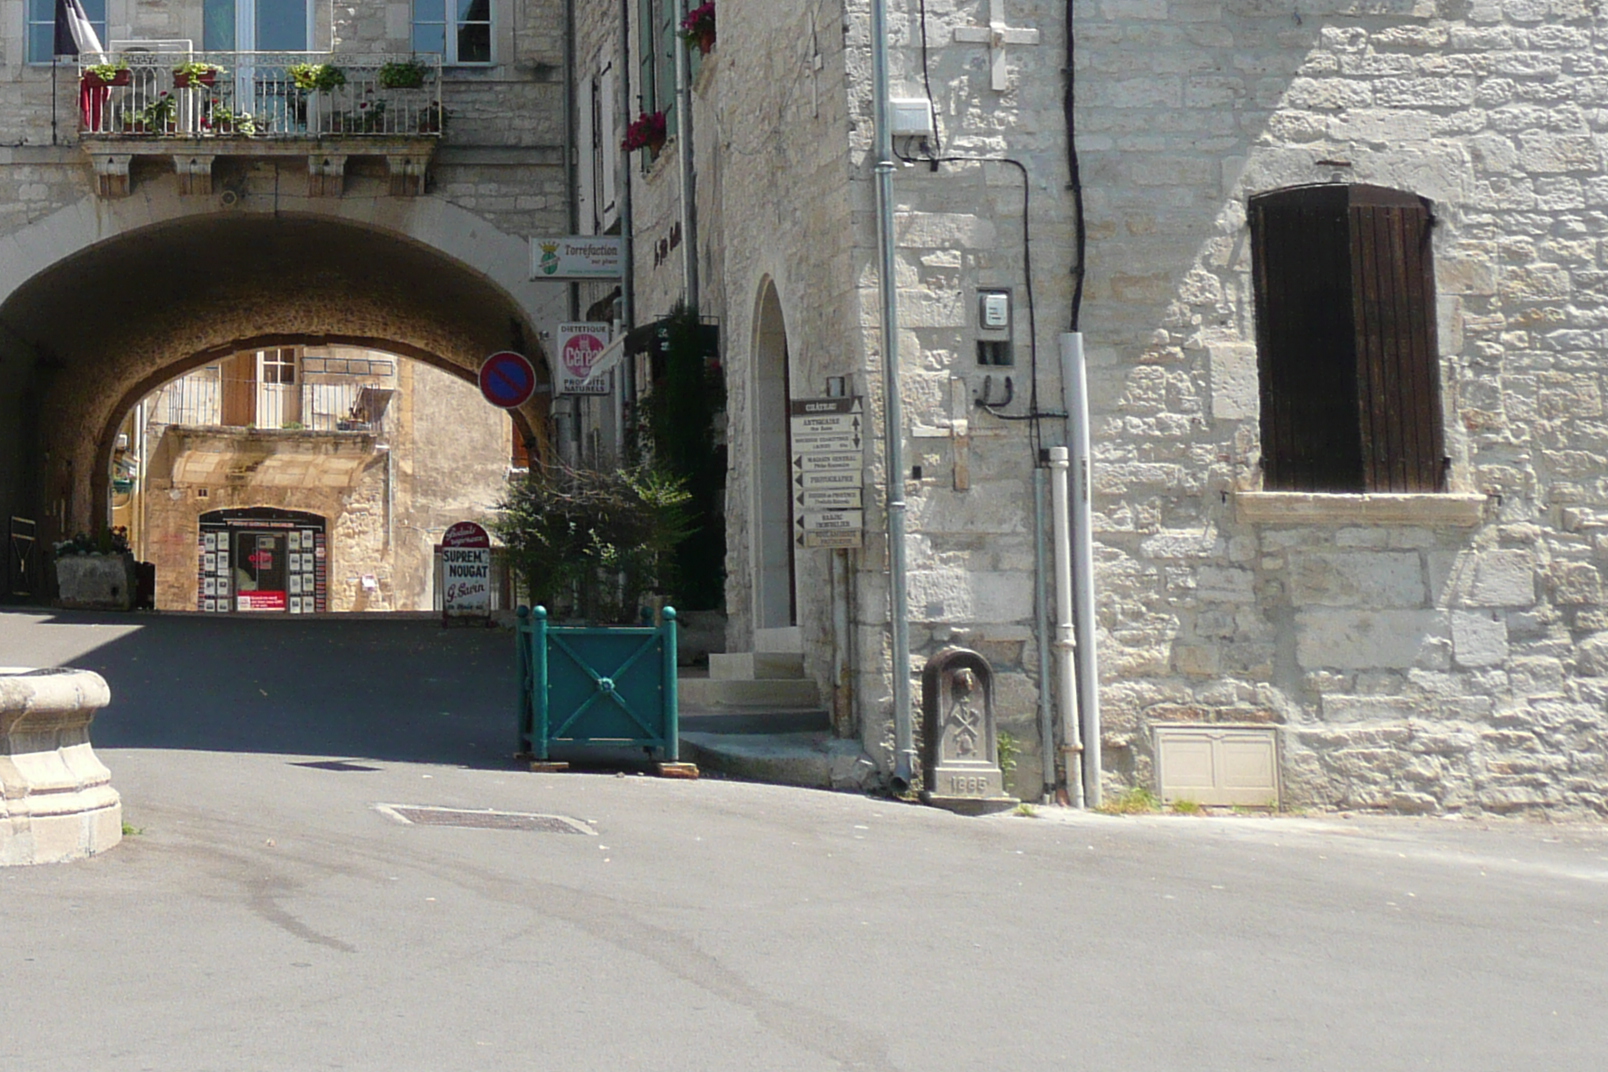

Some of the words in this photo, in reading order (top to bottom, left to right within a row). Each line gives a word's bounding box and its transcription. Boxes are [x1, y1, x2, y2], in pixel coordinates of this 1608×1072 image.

[565, 243, 618, 259] Torréfaction
[561, 325, 606, 333] DIETETIQUE
[566, 346, 602, 367] Céréa
[449, 565, 488, 578] NOUGAT
